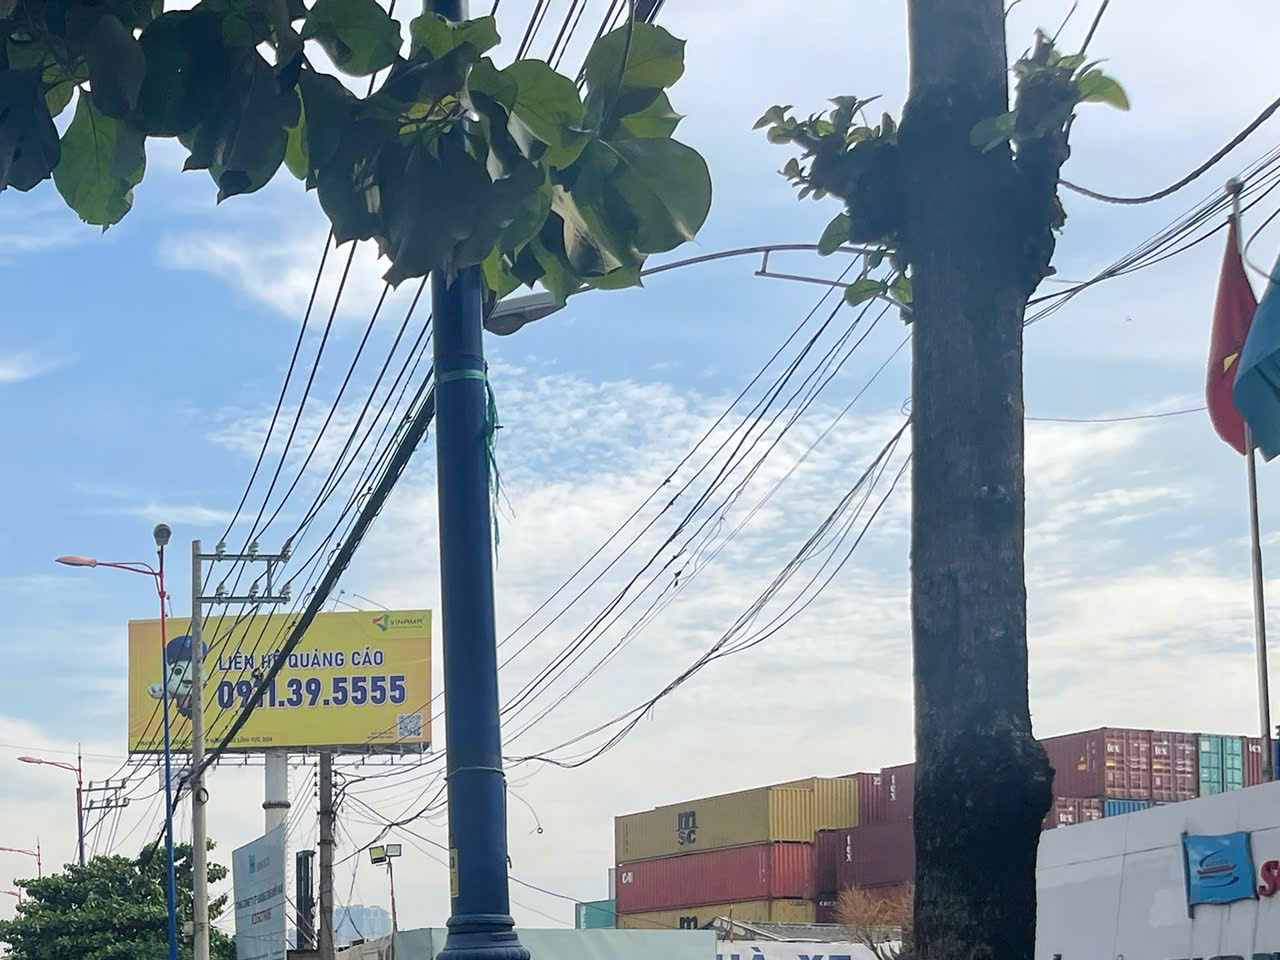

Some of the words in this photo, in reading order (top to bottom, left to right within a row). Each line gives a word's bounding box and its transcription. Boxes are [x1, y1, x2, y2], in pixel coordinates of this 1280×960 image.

[219, 652, 254, 671] LIÊN
[288, 648, 345, 668] QUẢNG
[351, 646, 384, 666] CÁO
[218, 675, 406, 709] 0911.39.5555
[1258, 859, 1280, 898] S
